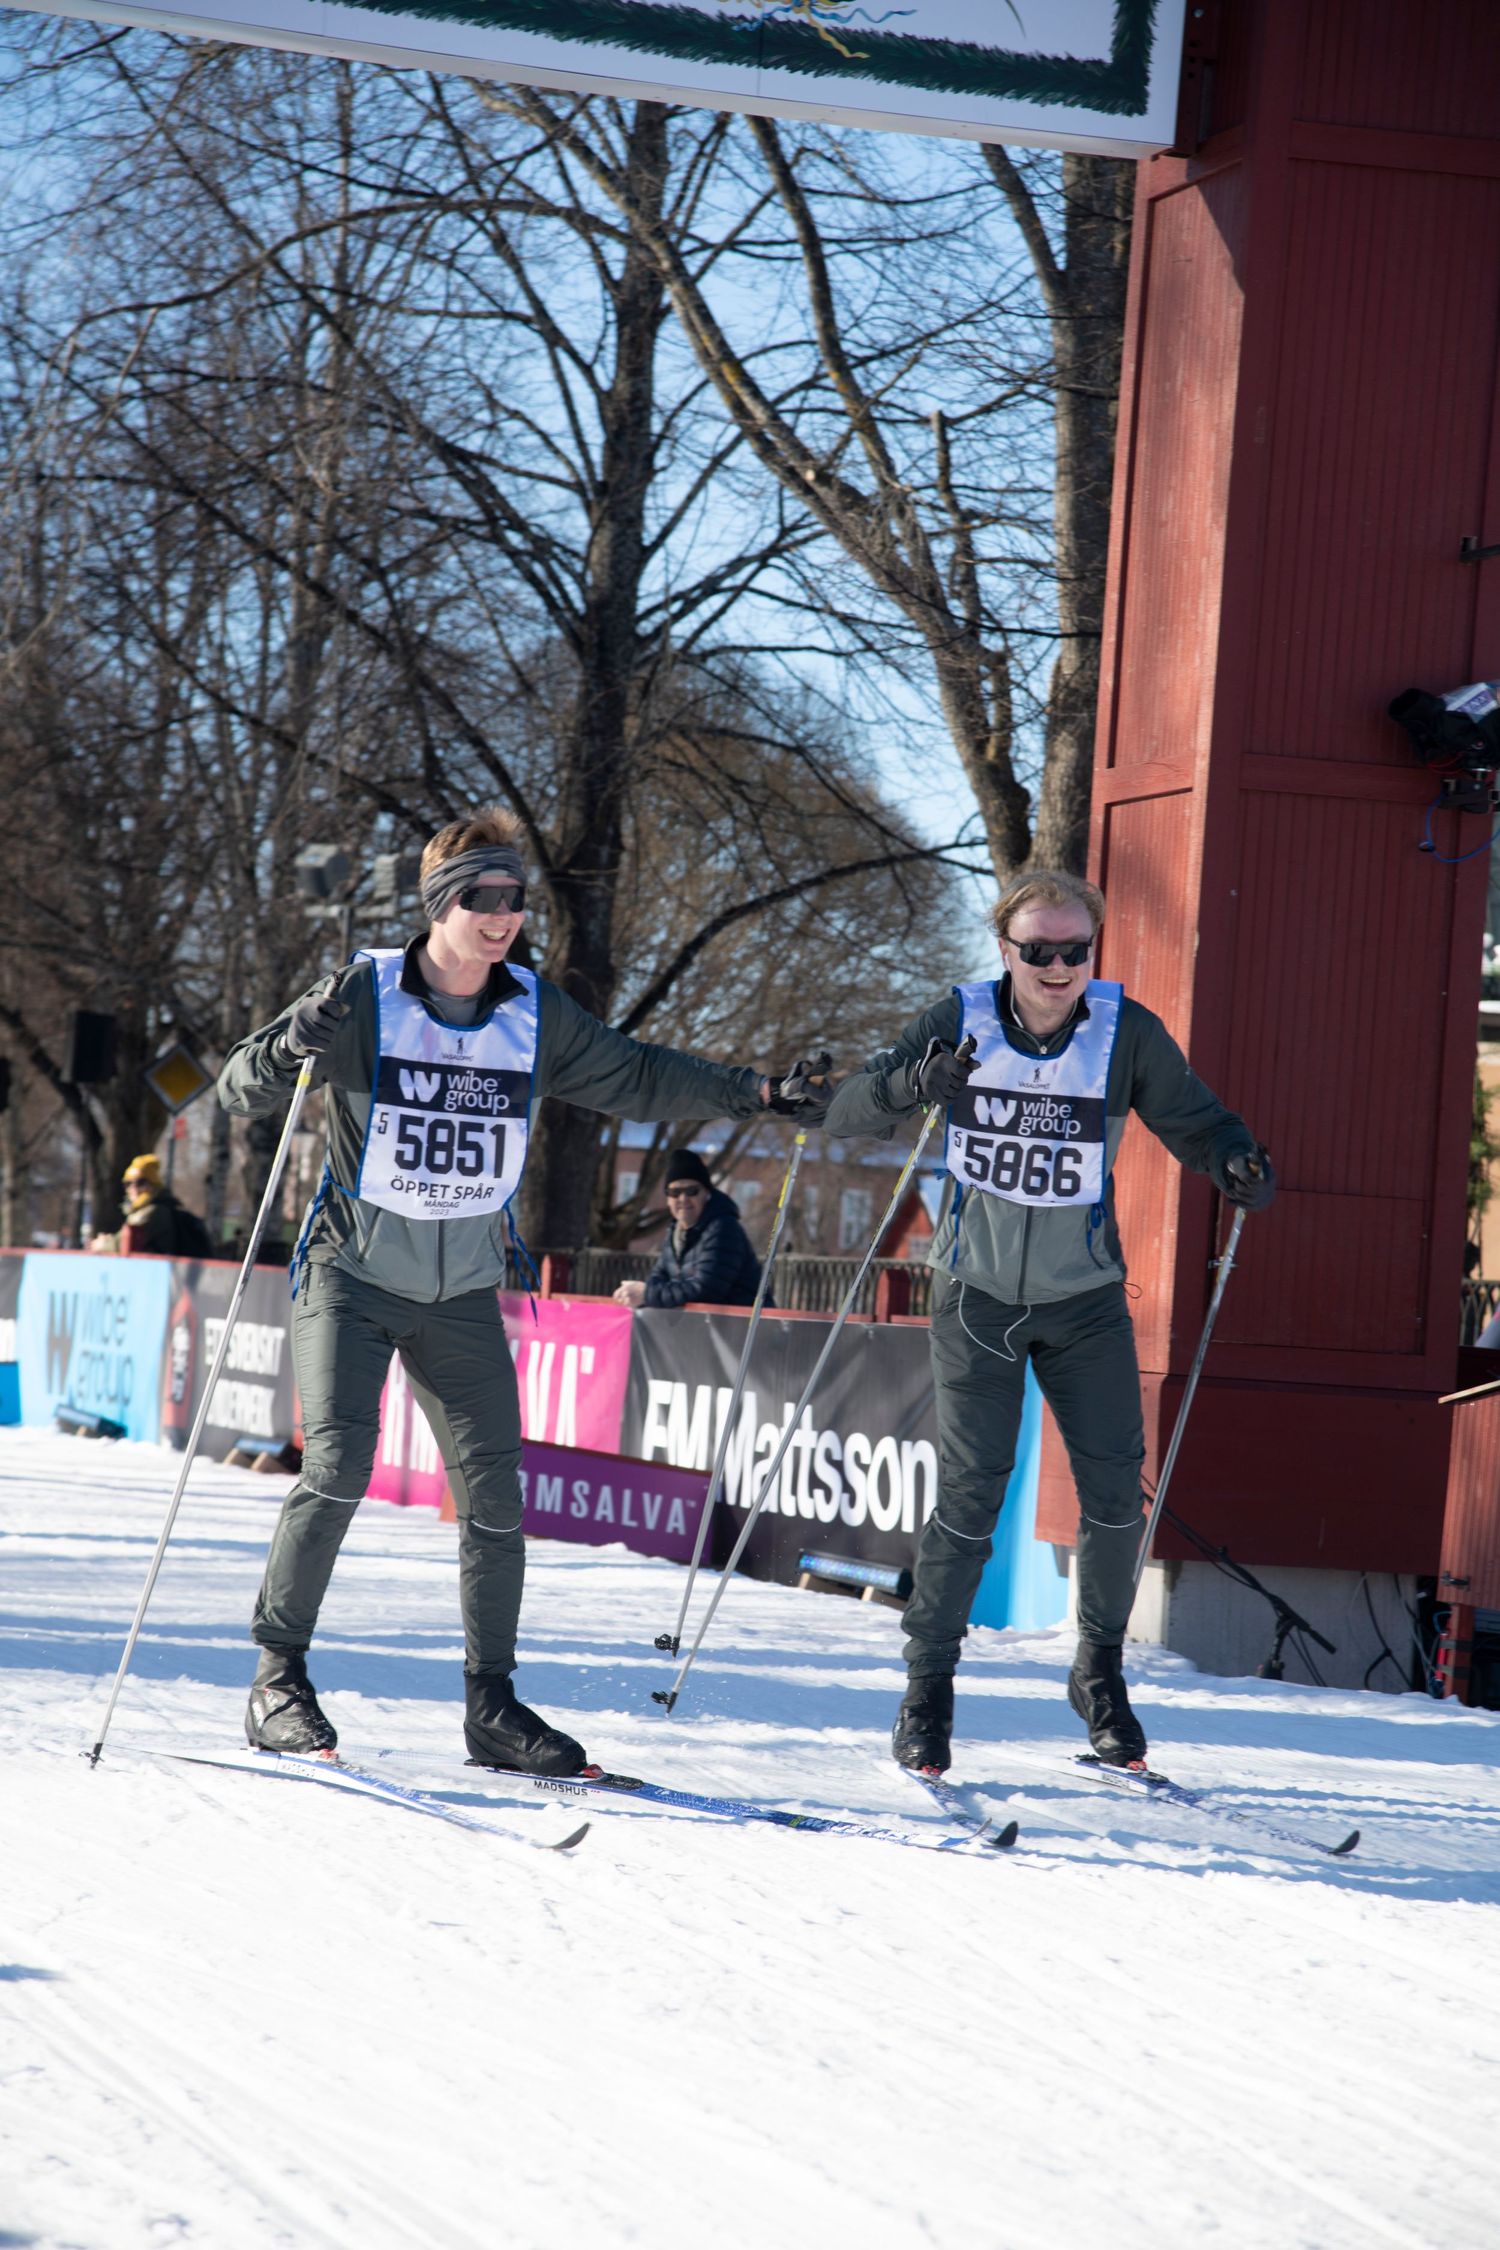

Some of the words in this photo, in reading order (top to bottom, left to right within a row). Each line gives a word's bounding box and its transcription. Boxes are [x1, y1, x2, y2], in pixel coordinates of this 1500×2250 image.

[447, 1069, 499, 1094] wibe
[443, 1089, 510, 1115] group
[1022, 1097, 1072, 1118] wibe
[1018, 1115, 1082, 1139] group
[394, 1113, 507, 1179] 5851
[963, 1134, 1083, 1198] 5866
[390, 1174, 451, 1199] ÖPPET
[452, 1182, 495, 1200] SPÅR
[423, 1200, 461, 1209] MÅNDAG
[641, 1378, 713, 1471] FM
[713, 1385, 939, 1533] Mattsson
[533, 1780, 588, 1797] MADSHUS
